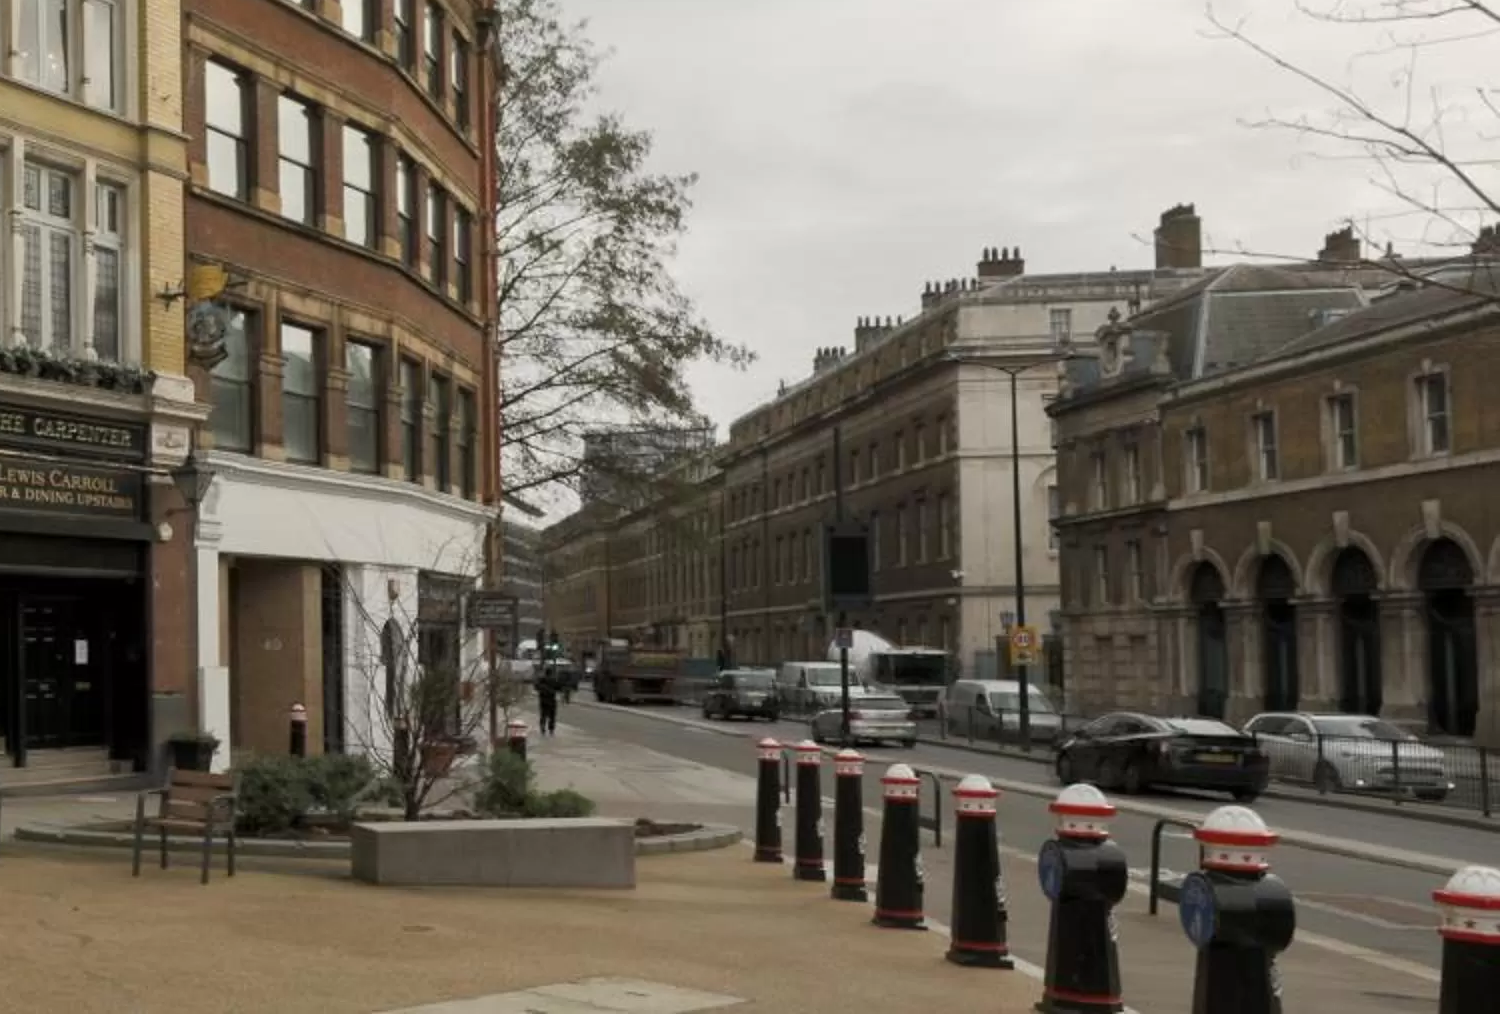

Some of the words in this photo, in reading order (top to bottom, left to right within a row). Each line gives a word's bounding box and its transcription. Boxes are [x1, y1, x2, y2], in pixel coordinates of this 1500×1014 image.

[32, 417, 133, 447] CARPENTER
[11, 486, 21, 499] &
[25, 488, 75, 504] DINING
[77, 493, 134, 509] UPSTAIRS
